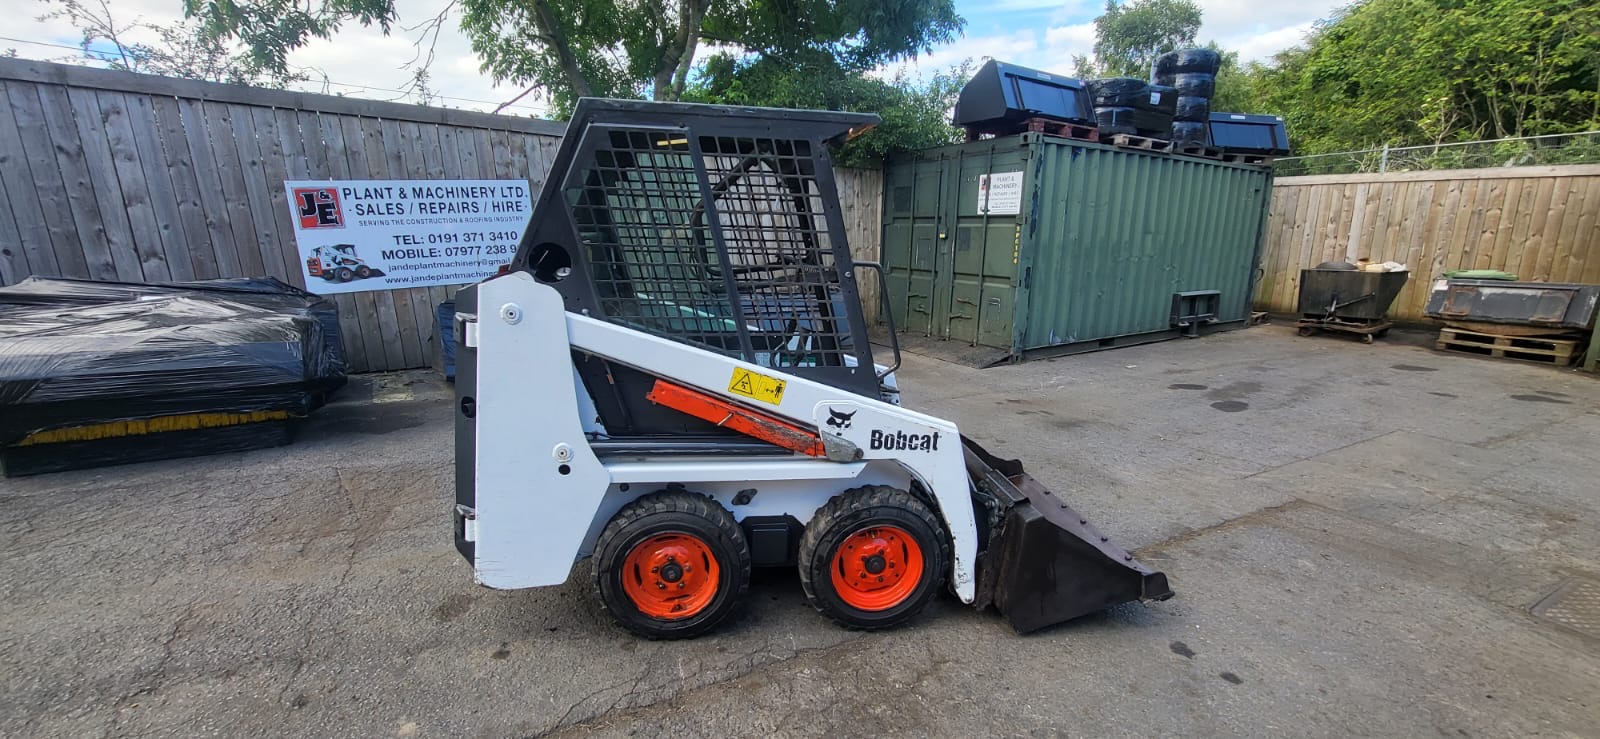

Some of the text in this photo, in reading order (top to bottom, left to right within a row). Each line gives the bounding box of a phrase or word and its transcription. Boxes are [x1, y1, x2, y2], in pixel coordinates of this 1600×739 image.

[342, 186, 528, 200] PLANT & MACHINERY LTD.
[355, 202, 405, 216] SALES
[418, 201, 480, 215] REPAIRS
[492, 200, 523, 213] HIRE
[358, 219, 390, 227] SERVING
[391, 218, 404, 226] THE
[405, 217, 458, 225] CONSTRUCTION
[493, 215, 523, 223] INDUSTRY
[392, 230, 518, 246] TEL: 0191 371 3410
[381, 244, 519, 260] MOBILE: 07977 238 9
[388, 257, 511, 272] jandeplantmachinery@gmail
[385, 270, 498, 284] www.jandeplantmachiner
[870, 429, 940, 453] Bobcat
